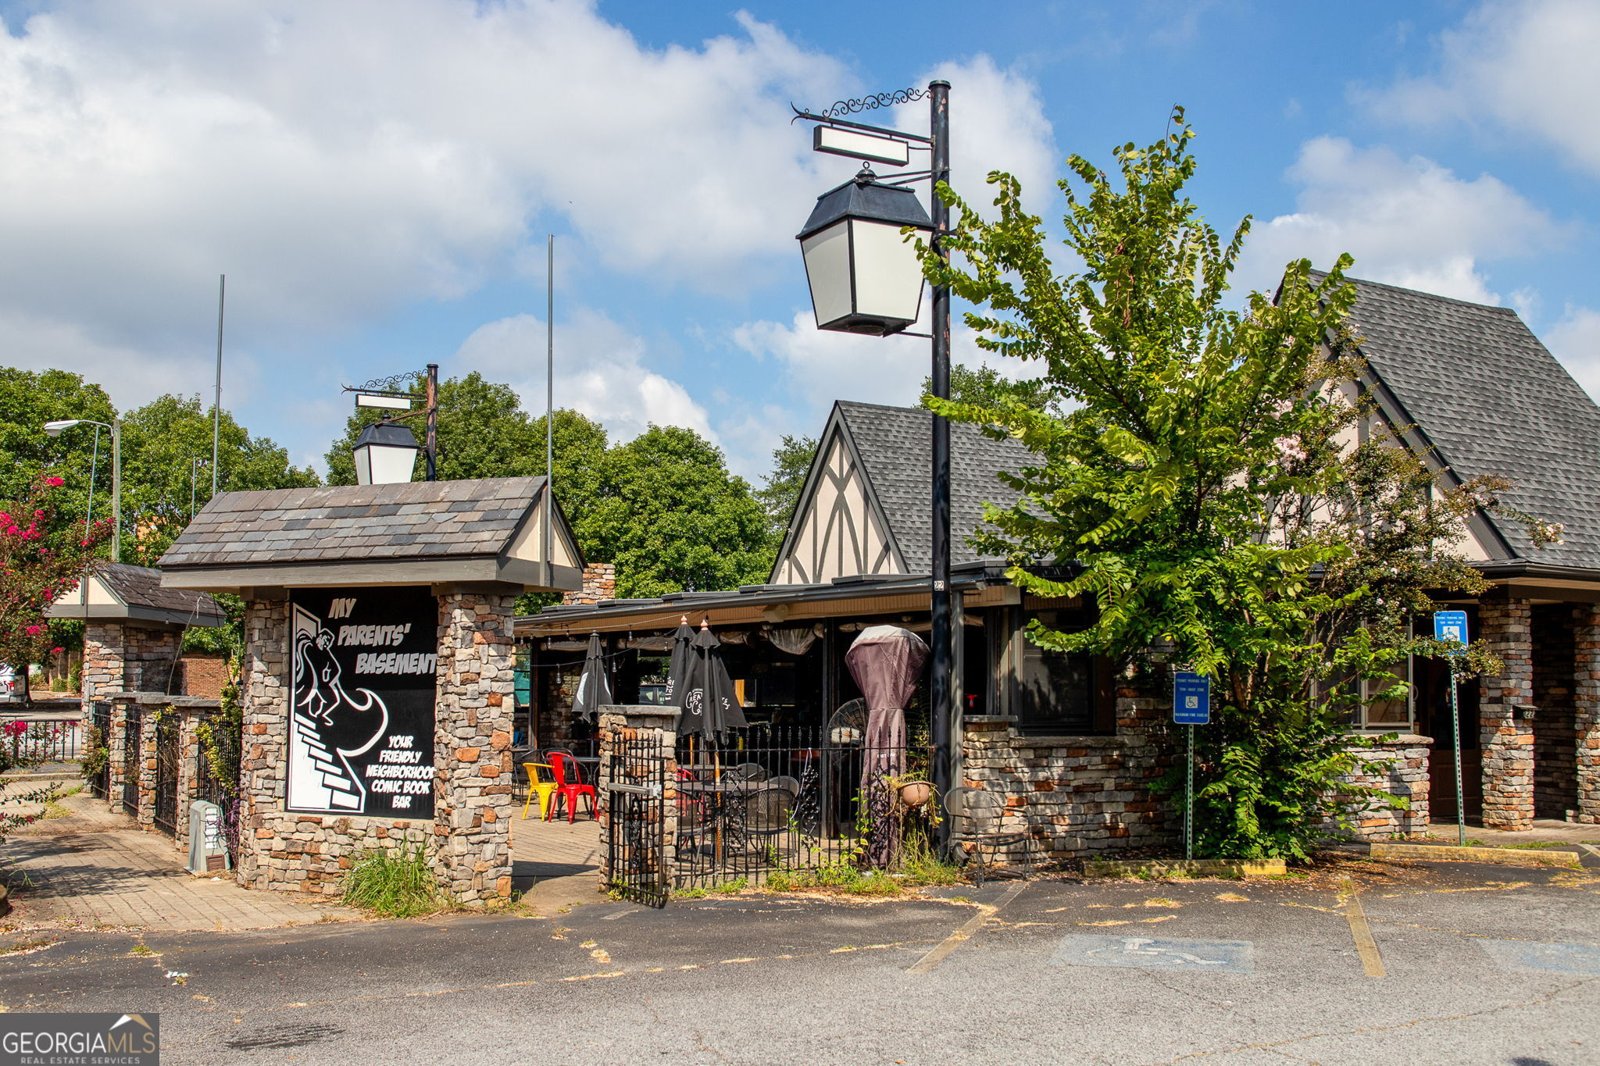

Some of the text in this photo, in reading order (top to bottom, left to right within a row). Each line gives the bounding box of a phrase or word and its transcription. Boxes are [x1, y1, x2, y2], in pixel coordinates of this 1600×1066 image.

[328, 598, 357, 619] MY
[337, 623, 412, 647] PARENTS'
[355, 652, 437, 675] BASEMENT
[388, 735, 414, 749] YOUR
[379, 750, 422, 764] FRIENDLY
[371, 779, 431, 795] COMIC BOOK
[392, 795, 412, 809] BAR
